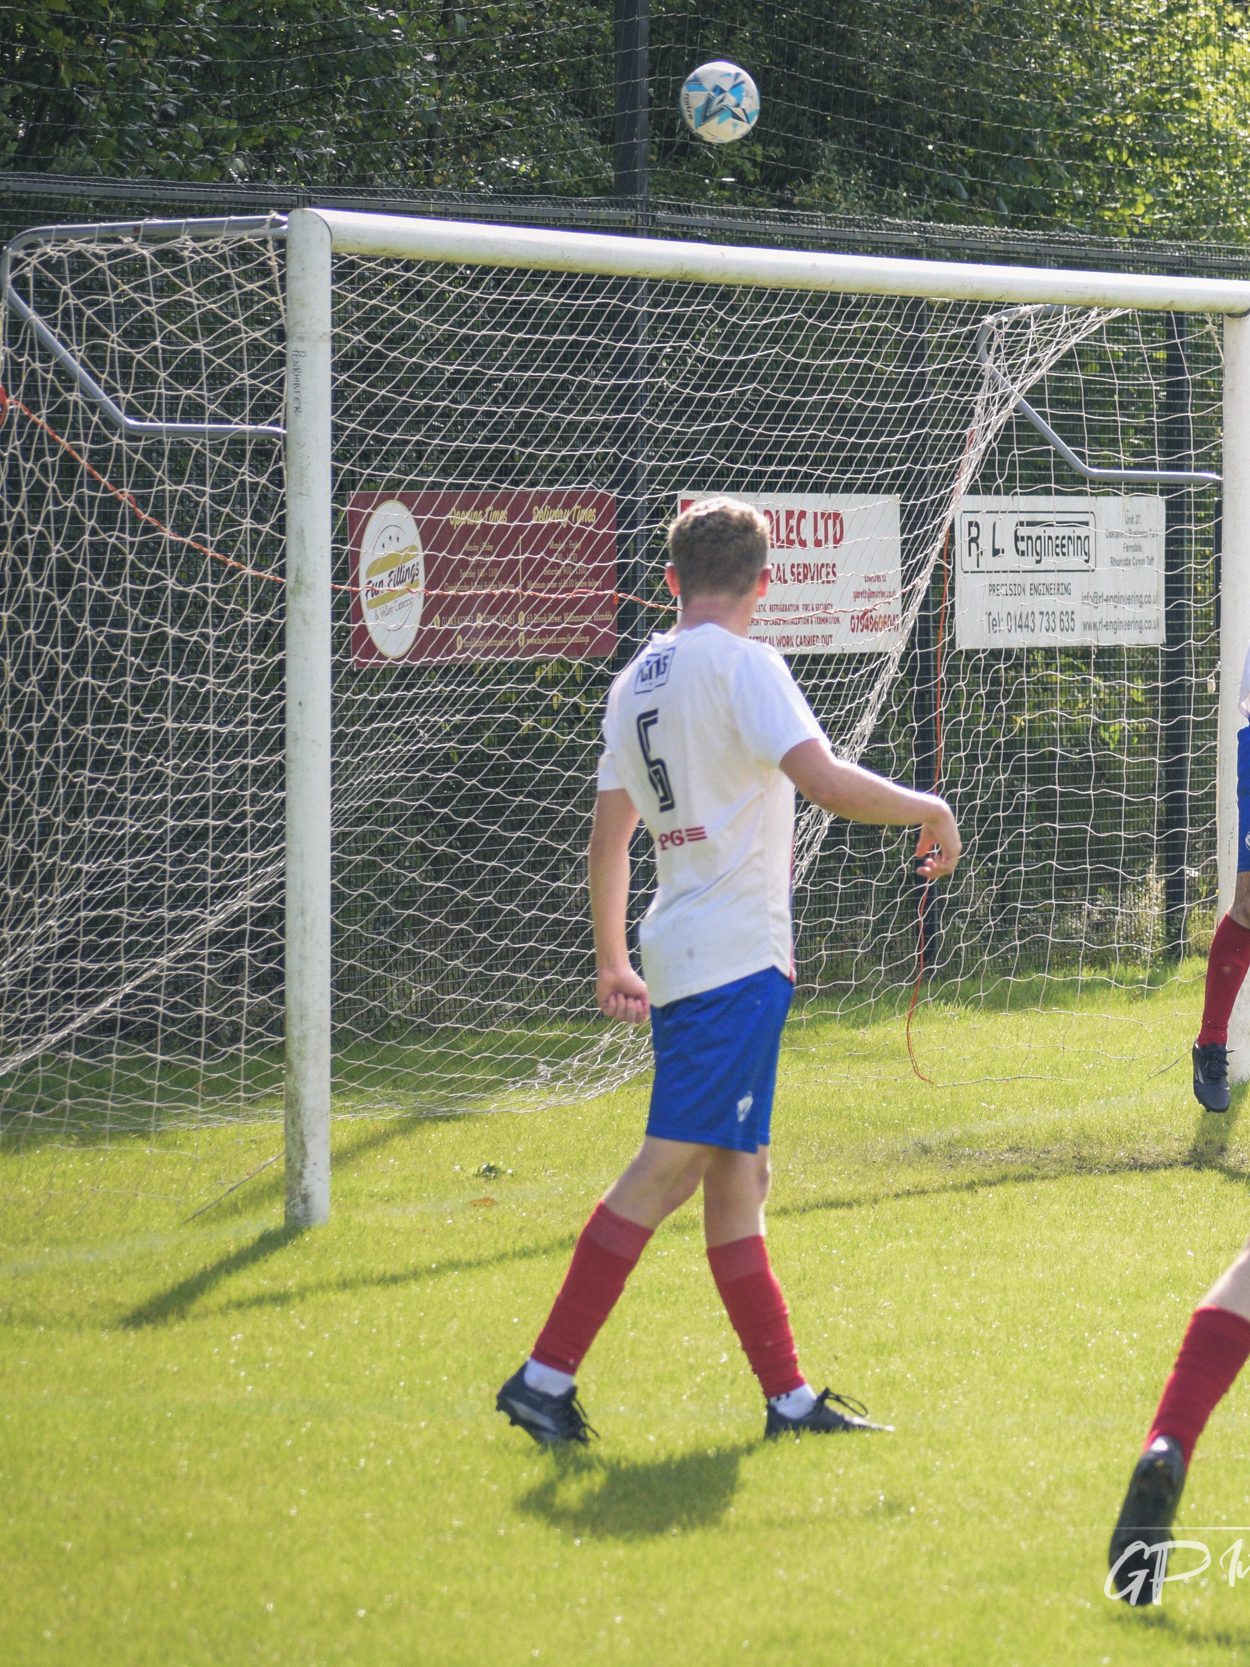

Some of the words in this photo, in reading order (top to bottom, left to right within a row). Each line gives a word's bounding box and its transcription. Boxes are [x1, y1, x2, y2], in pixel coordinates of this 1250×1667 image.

[449, 506, 482, 530] Opening
[484, 507, 508, 524] Times
[532, 505, 570, 528] Delivery
[571, 504, 597, 524] Times
[764, 510, 807, 549] RLEC
[813, 510, 844, 549] LTD
[1014, 520, 1091, 564] Engineering
[387, 561, 420, 588] Fillings
[769, 562, 788, 585] CAL
[790, 562, 837, 585] SERVICES
[988, 582, 1026, 596] PRECISION
[1029, 582, 1072, 596] ENGINEERING
[1007, 611, 1036, 633] 01443
[1039, 611, 1056, 632] 733
[1059, 610, 1076, 632] 635
[776, 635, 794, 647] WORK
[821, 634, 833, 647] OUT
[637, 708, 675, 813] 5
